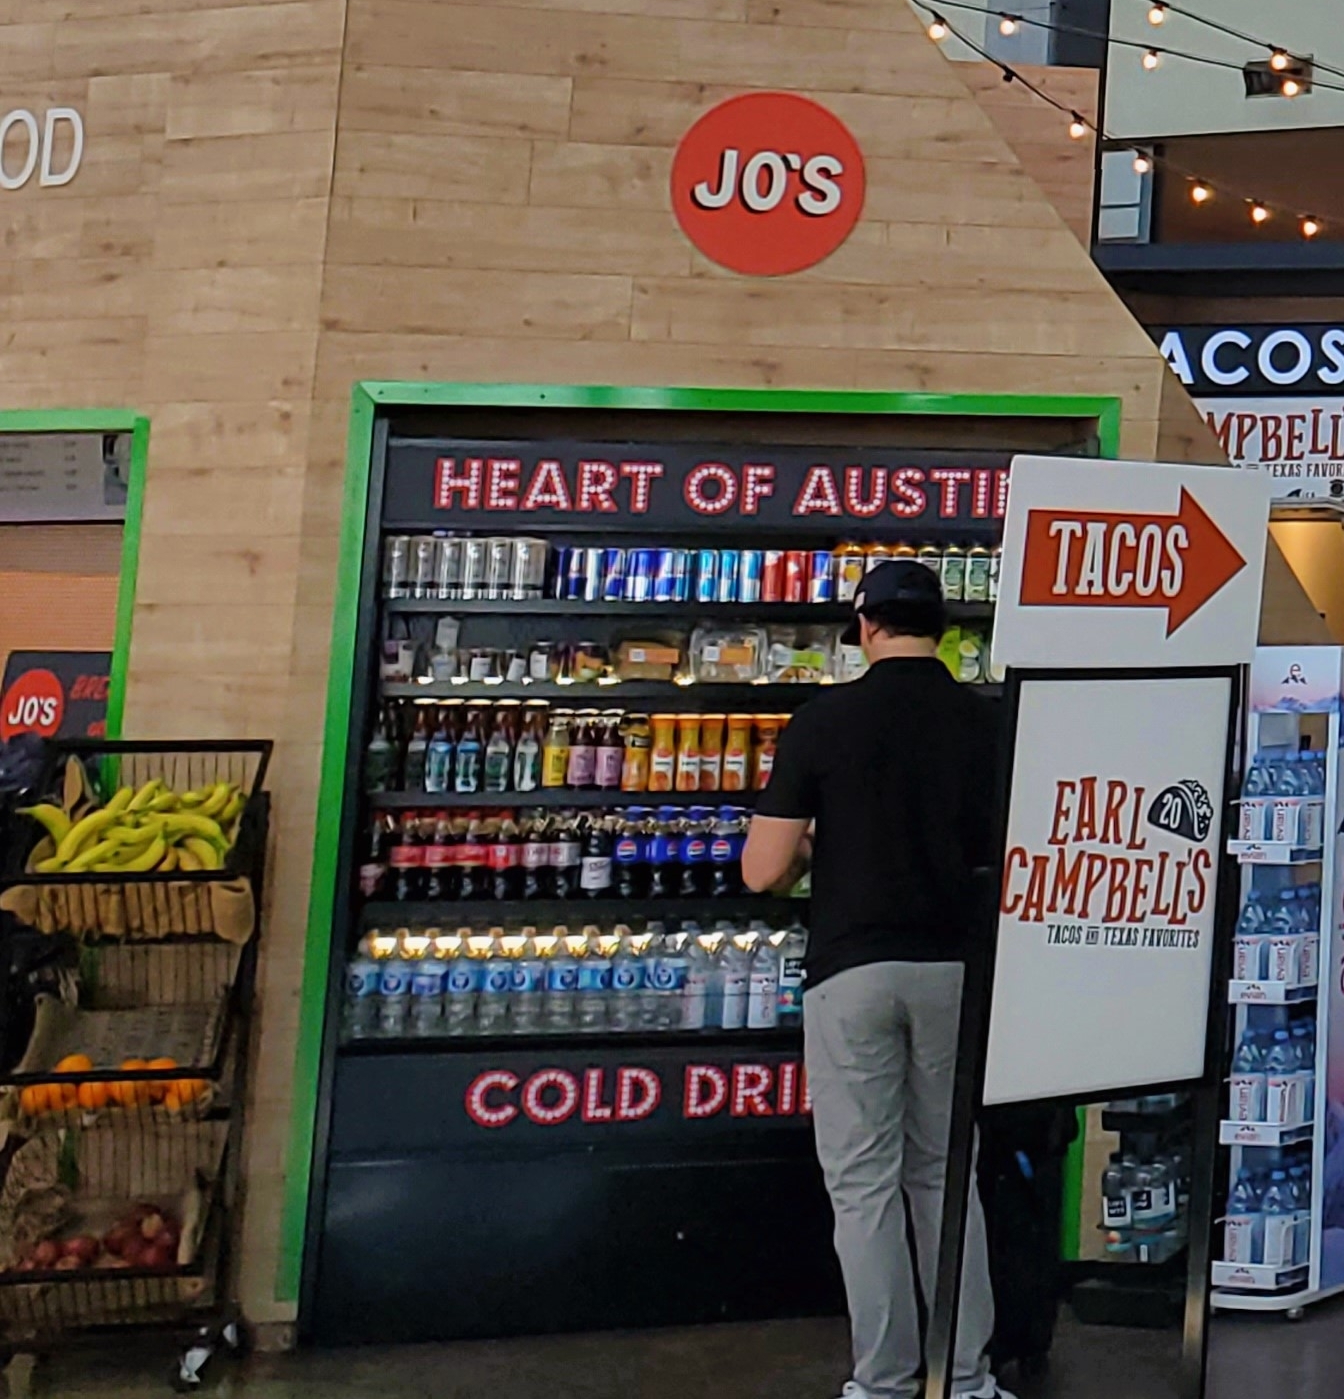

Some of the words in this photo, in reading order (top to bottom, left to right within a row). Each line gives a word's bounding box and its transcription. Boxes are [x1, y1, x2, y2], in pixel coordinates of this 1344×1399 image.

[693, 148, 843, 215] JO'S
[433, 458, 663, 513] HEART
[684, 464, 777, 515] OF
[1265, 463, 1302, 478] EXAS
[1048, 520, 1189, 597] TACOS
[8, 695, 58, 726] JO'S
[1047, 776, 1148, 851] EARL
[1160, 792, 1183, 830] 20
[999, 846, 1212, 925] CAMPBELL'S
[1047, 924, 1082, 945] TACOS
[1103, 925, 1139, 947] TEXAS
[1142, 927, 1200, 949] FAVORITES
[464, 1067, 662, 1128] COLD
